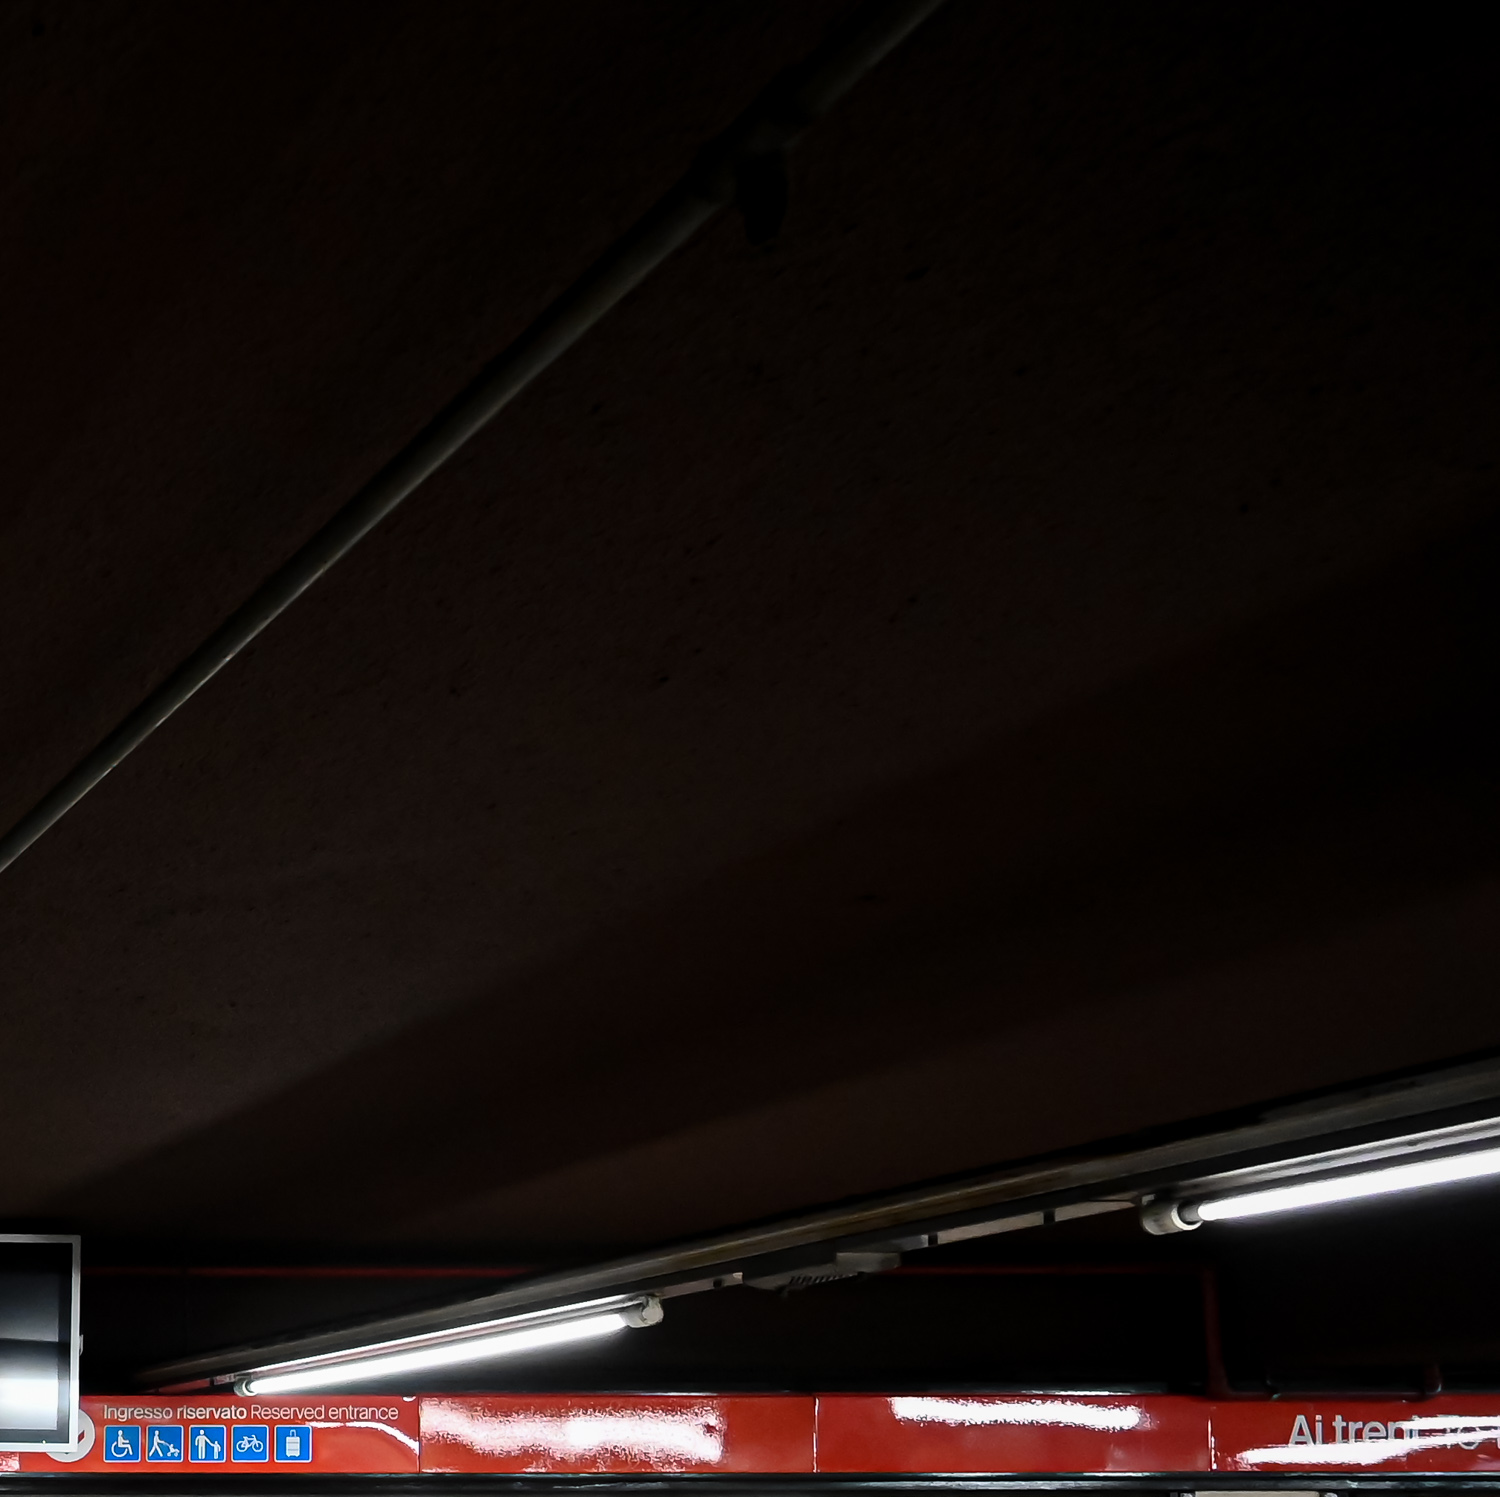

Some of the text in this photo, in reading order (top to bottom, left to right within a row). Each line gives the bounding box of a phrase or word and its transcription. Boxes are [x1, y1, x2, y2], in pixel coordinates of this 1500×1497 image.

[103, 1404, 399, 1422] Ingresso riservato Reserved entrance
[1288, 1414, 1323, 1446] Ai
